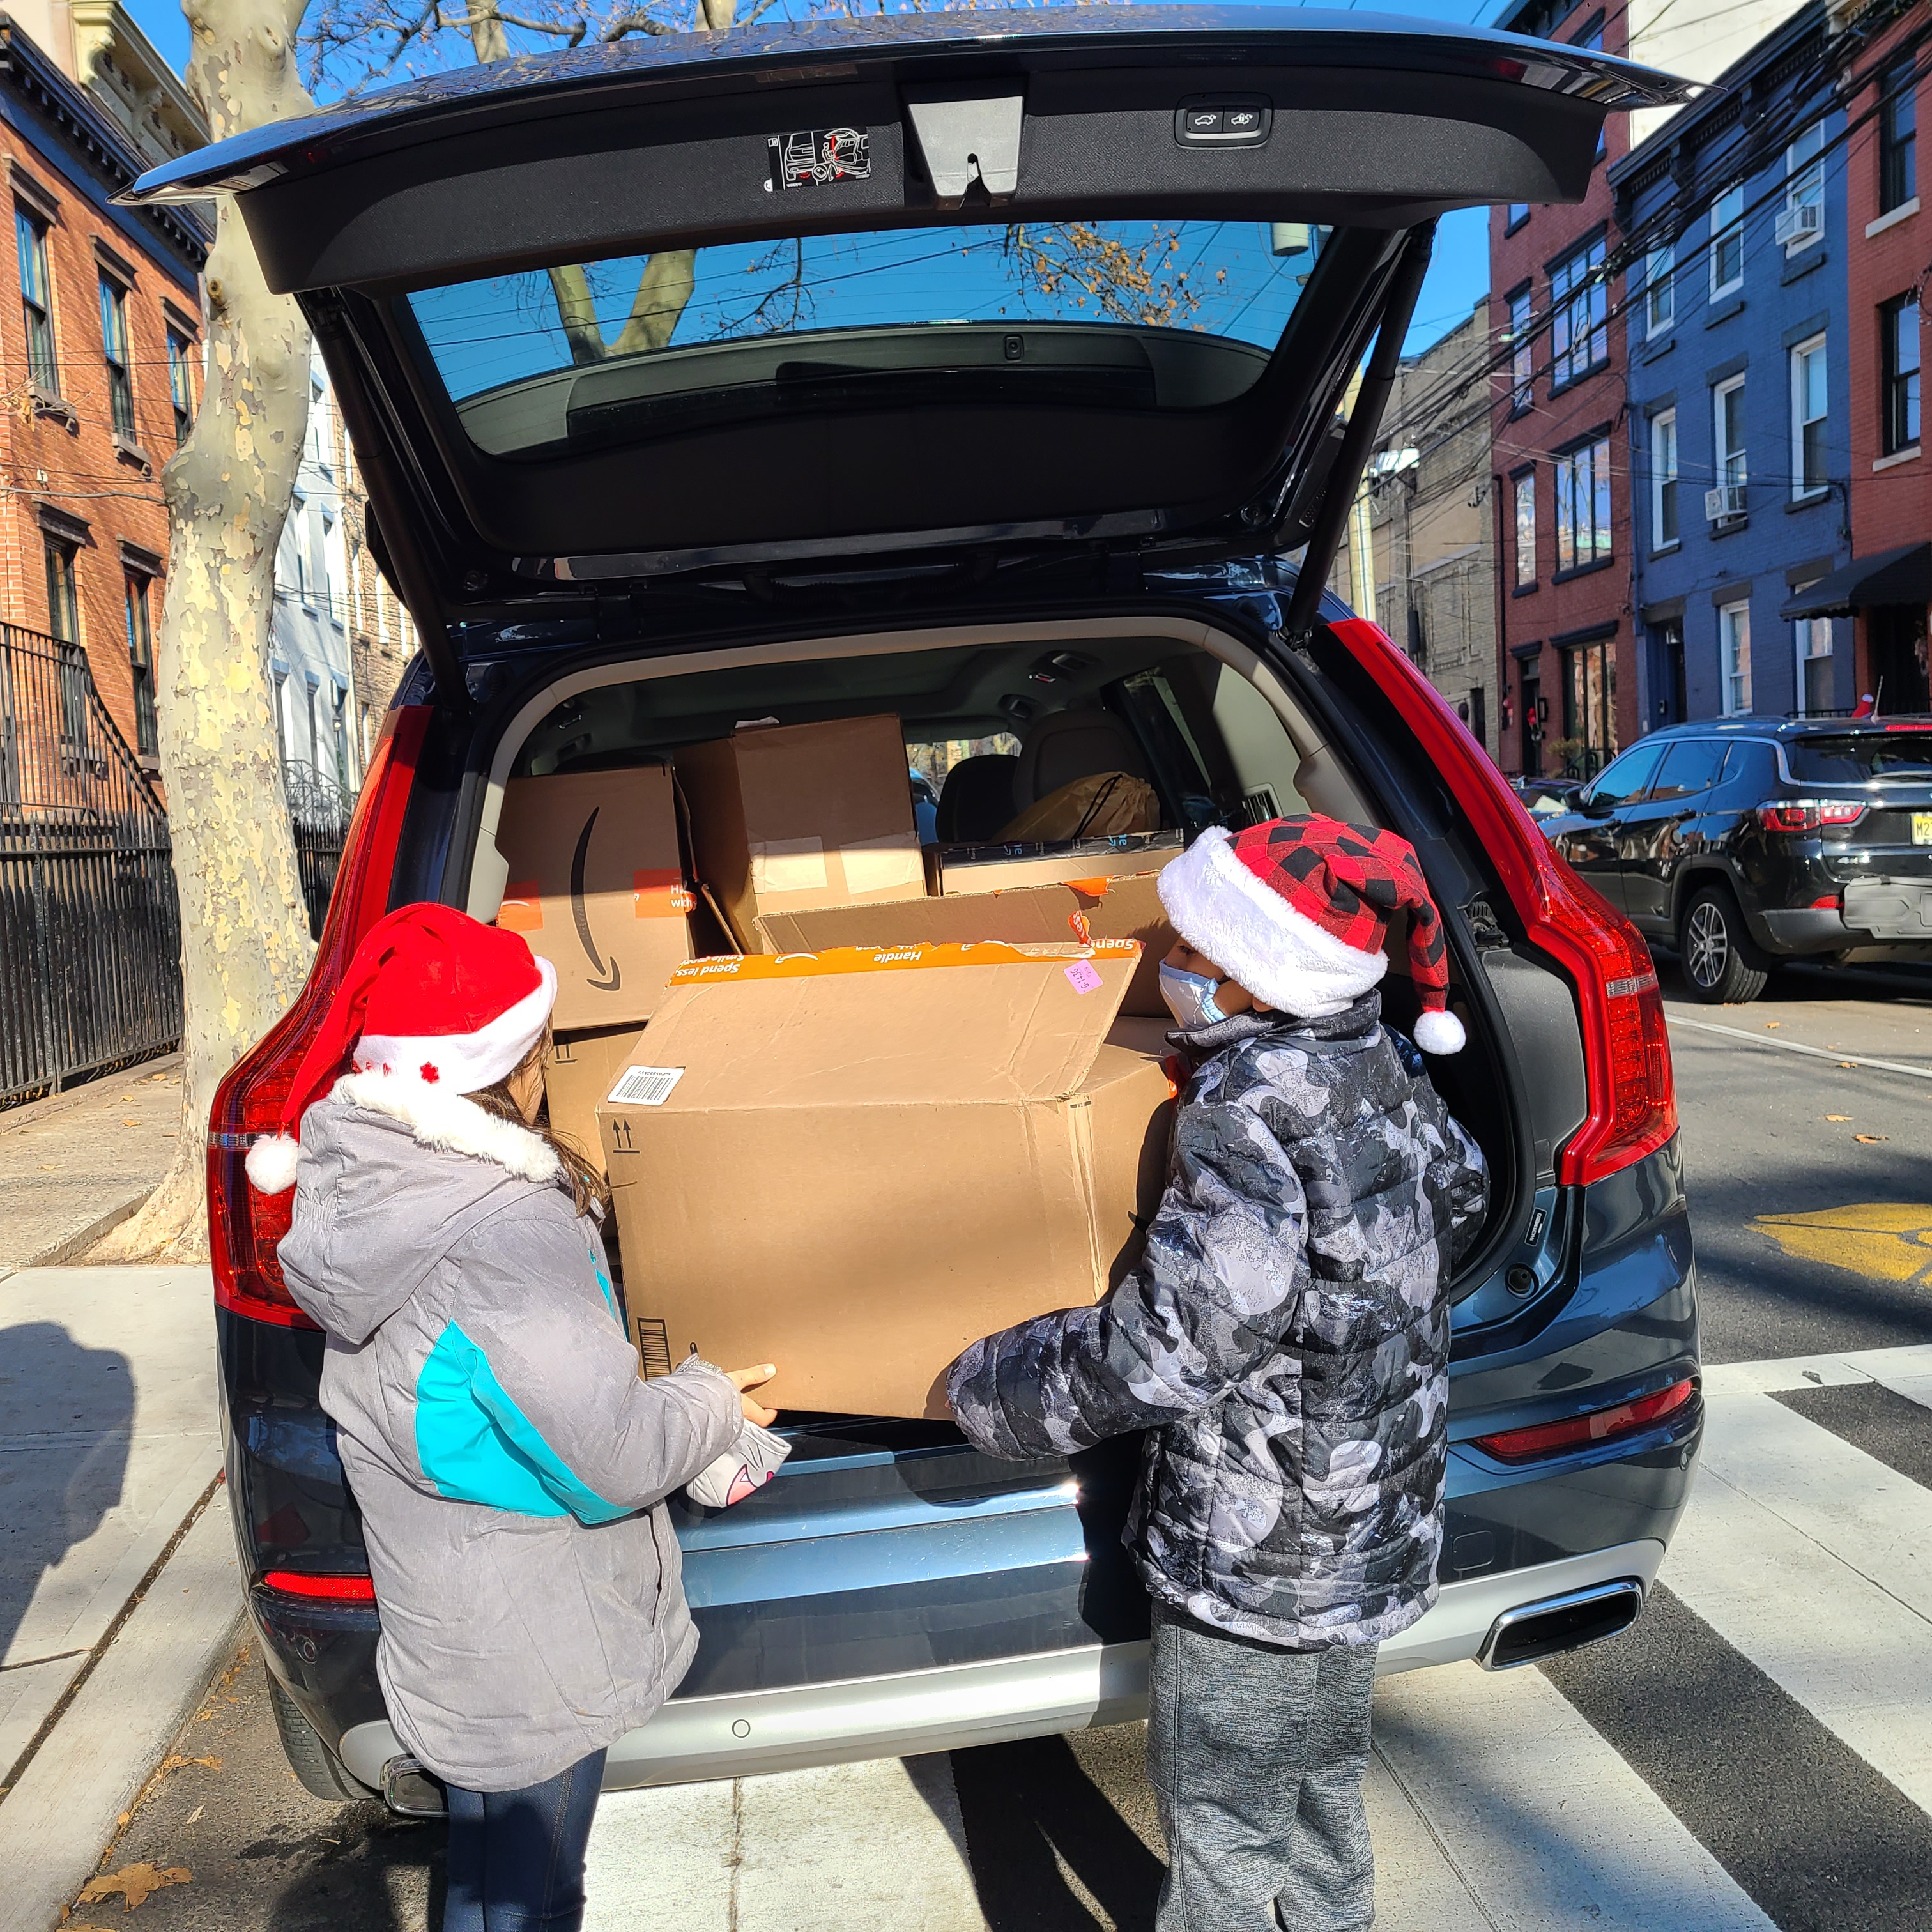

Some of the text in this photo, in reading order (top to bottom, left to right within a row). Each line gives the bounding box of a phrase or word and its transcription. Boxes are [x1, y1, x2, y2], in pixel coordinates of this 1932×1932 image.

[1091, 939, 1135, 950] Spen
[873, 951, 922, 963] Handle
[700, 962, 741, 976] Spend
